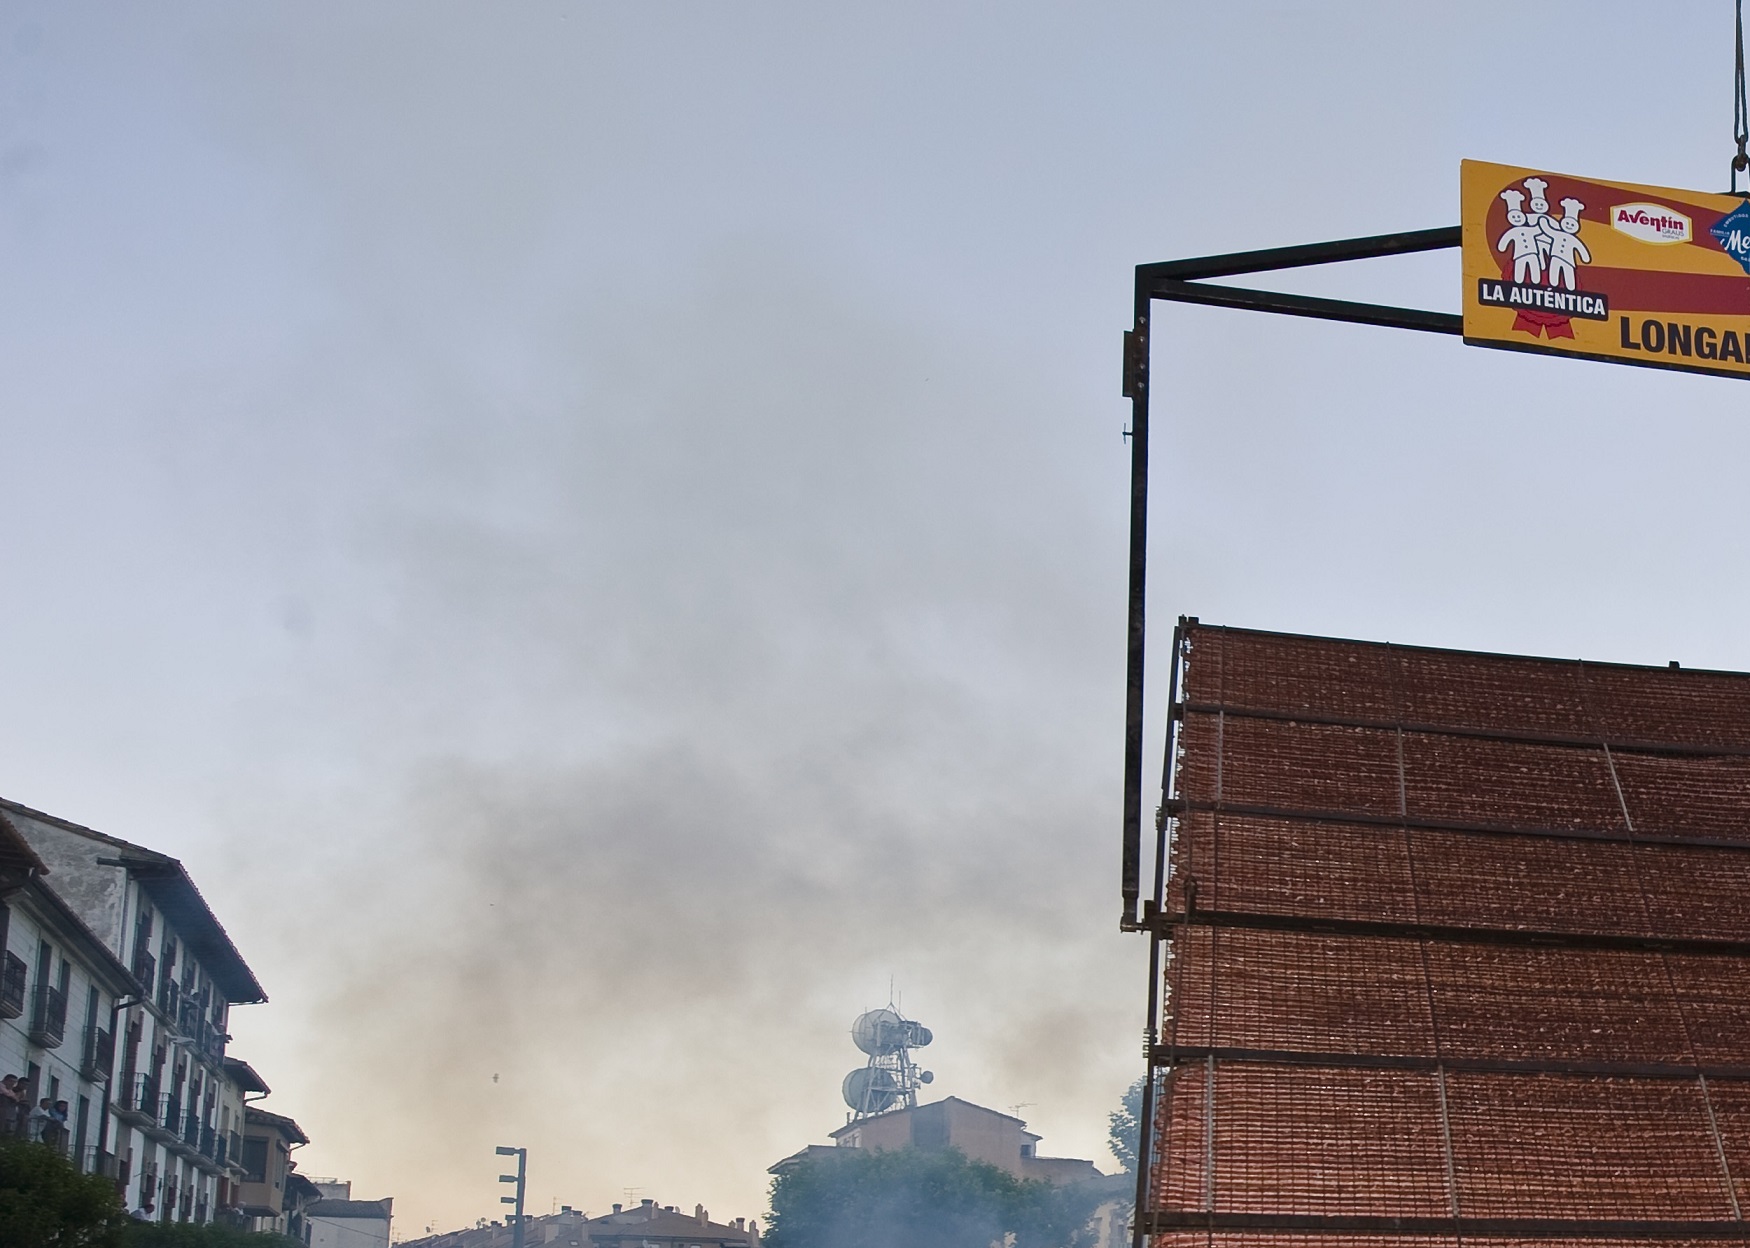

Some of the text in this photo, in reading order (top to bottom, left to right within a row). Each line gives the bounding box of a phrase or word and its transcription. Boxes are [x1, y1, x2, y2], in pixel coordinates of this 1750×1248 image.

[1662, 228, 1685, 237] GRAUS
[1482, 283, 1606, 316] LA AUTÉNTICA
